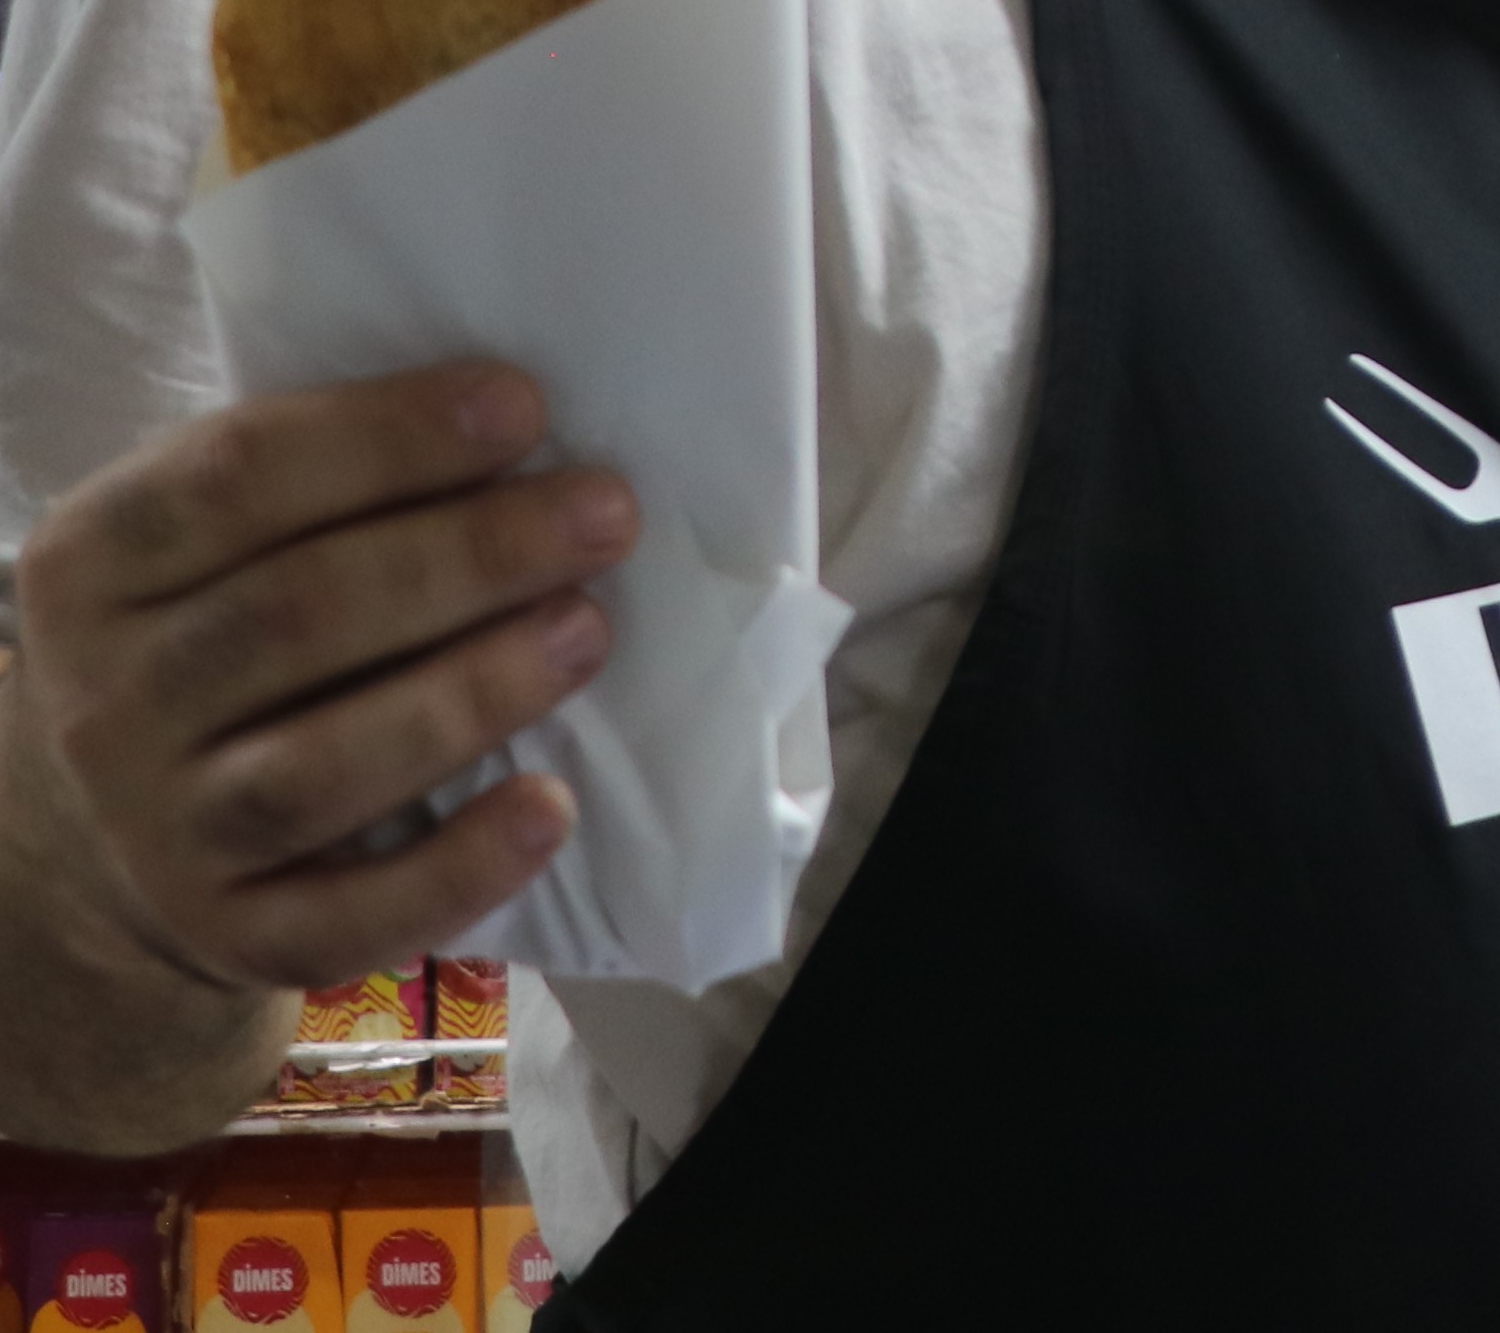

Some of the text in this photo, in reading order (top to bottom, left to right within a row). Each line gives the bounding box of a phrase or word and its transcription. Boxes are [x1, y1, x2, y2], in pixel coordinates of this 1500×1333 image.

[66, 1268, 127, 1299] DİMES
[232, 1263, 293, 1293] DİMES
[381, 1257, 441, 1287] DİMES
